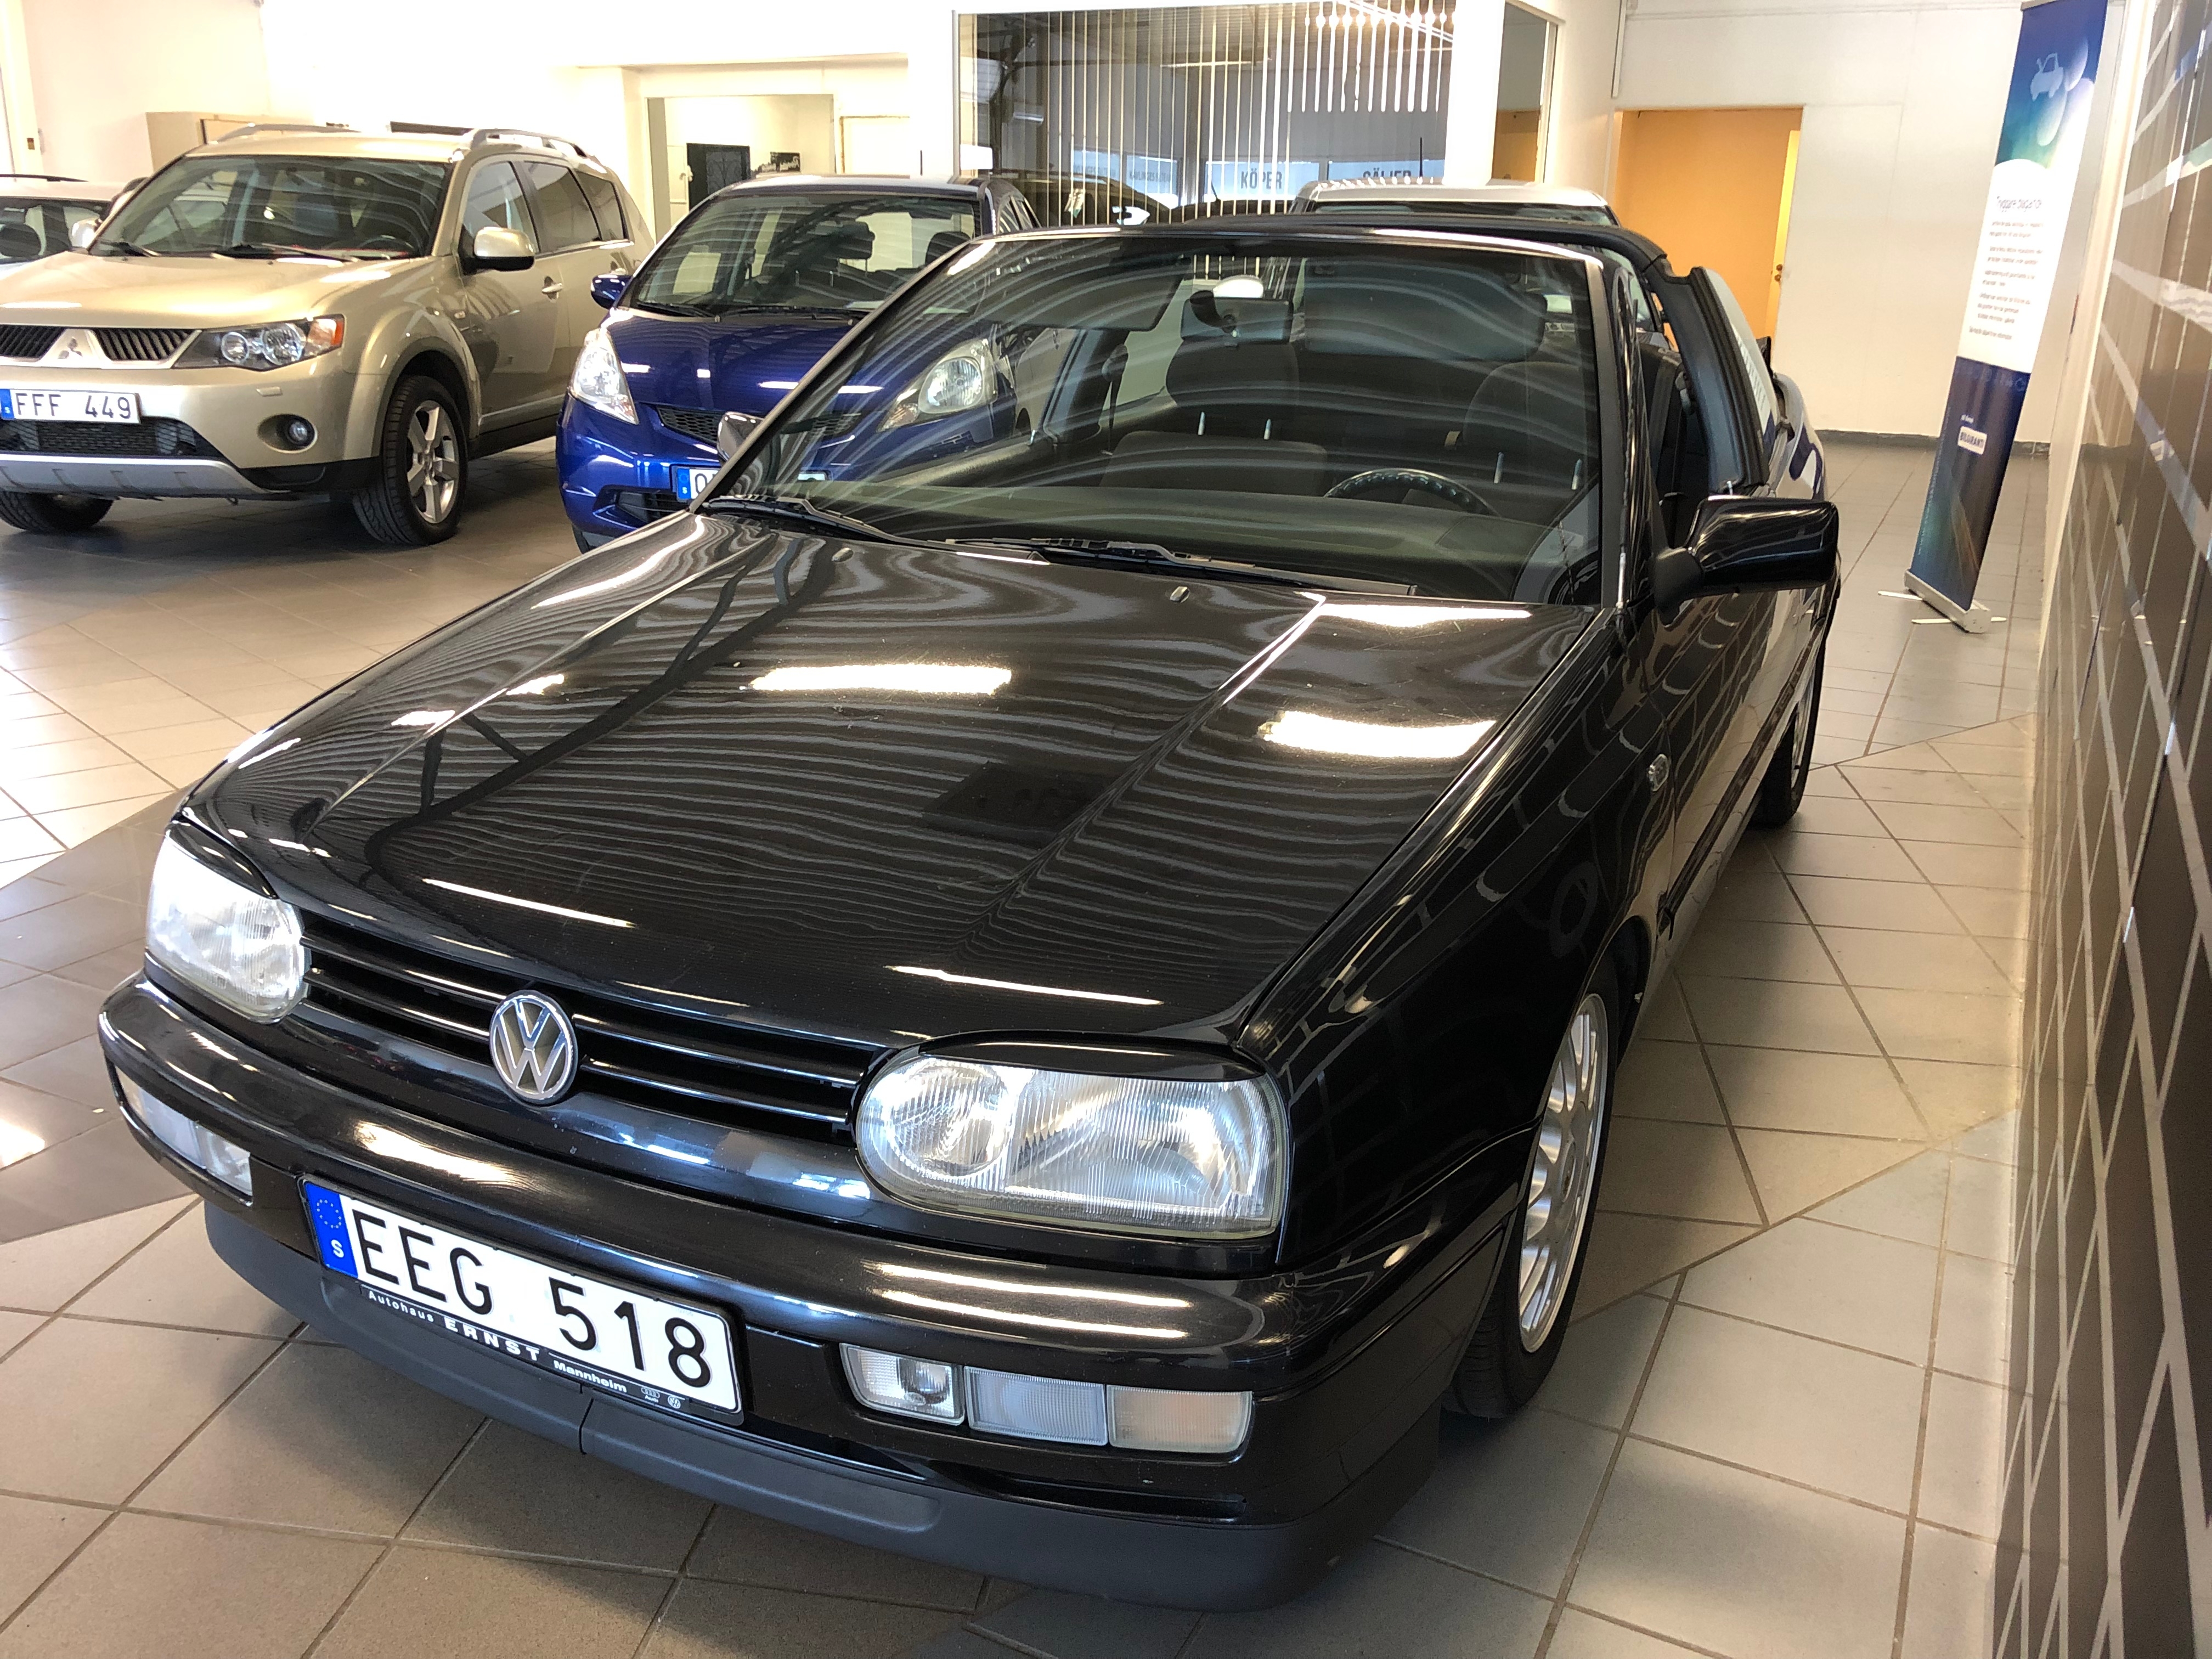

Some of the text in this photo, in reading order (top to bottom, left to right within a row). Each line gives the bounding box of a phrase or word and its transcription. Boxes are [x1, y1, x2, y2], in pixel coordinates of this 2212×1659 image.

[1240, 168, 1283, 189] KÖPER
[15, 392, 61, 416] FFF
[85, 394, 131, 419] 449
[331, 1209, 712, 1388] S EEG 518
[369, 1290, 627, 1393] Autohaus ERNST Mannheim
